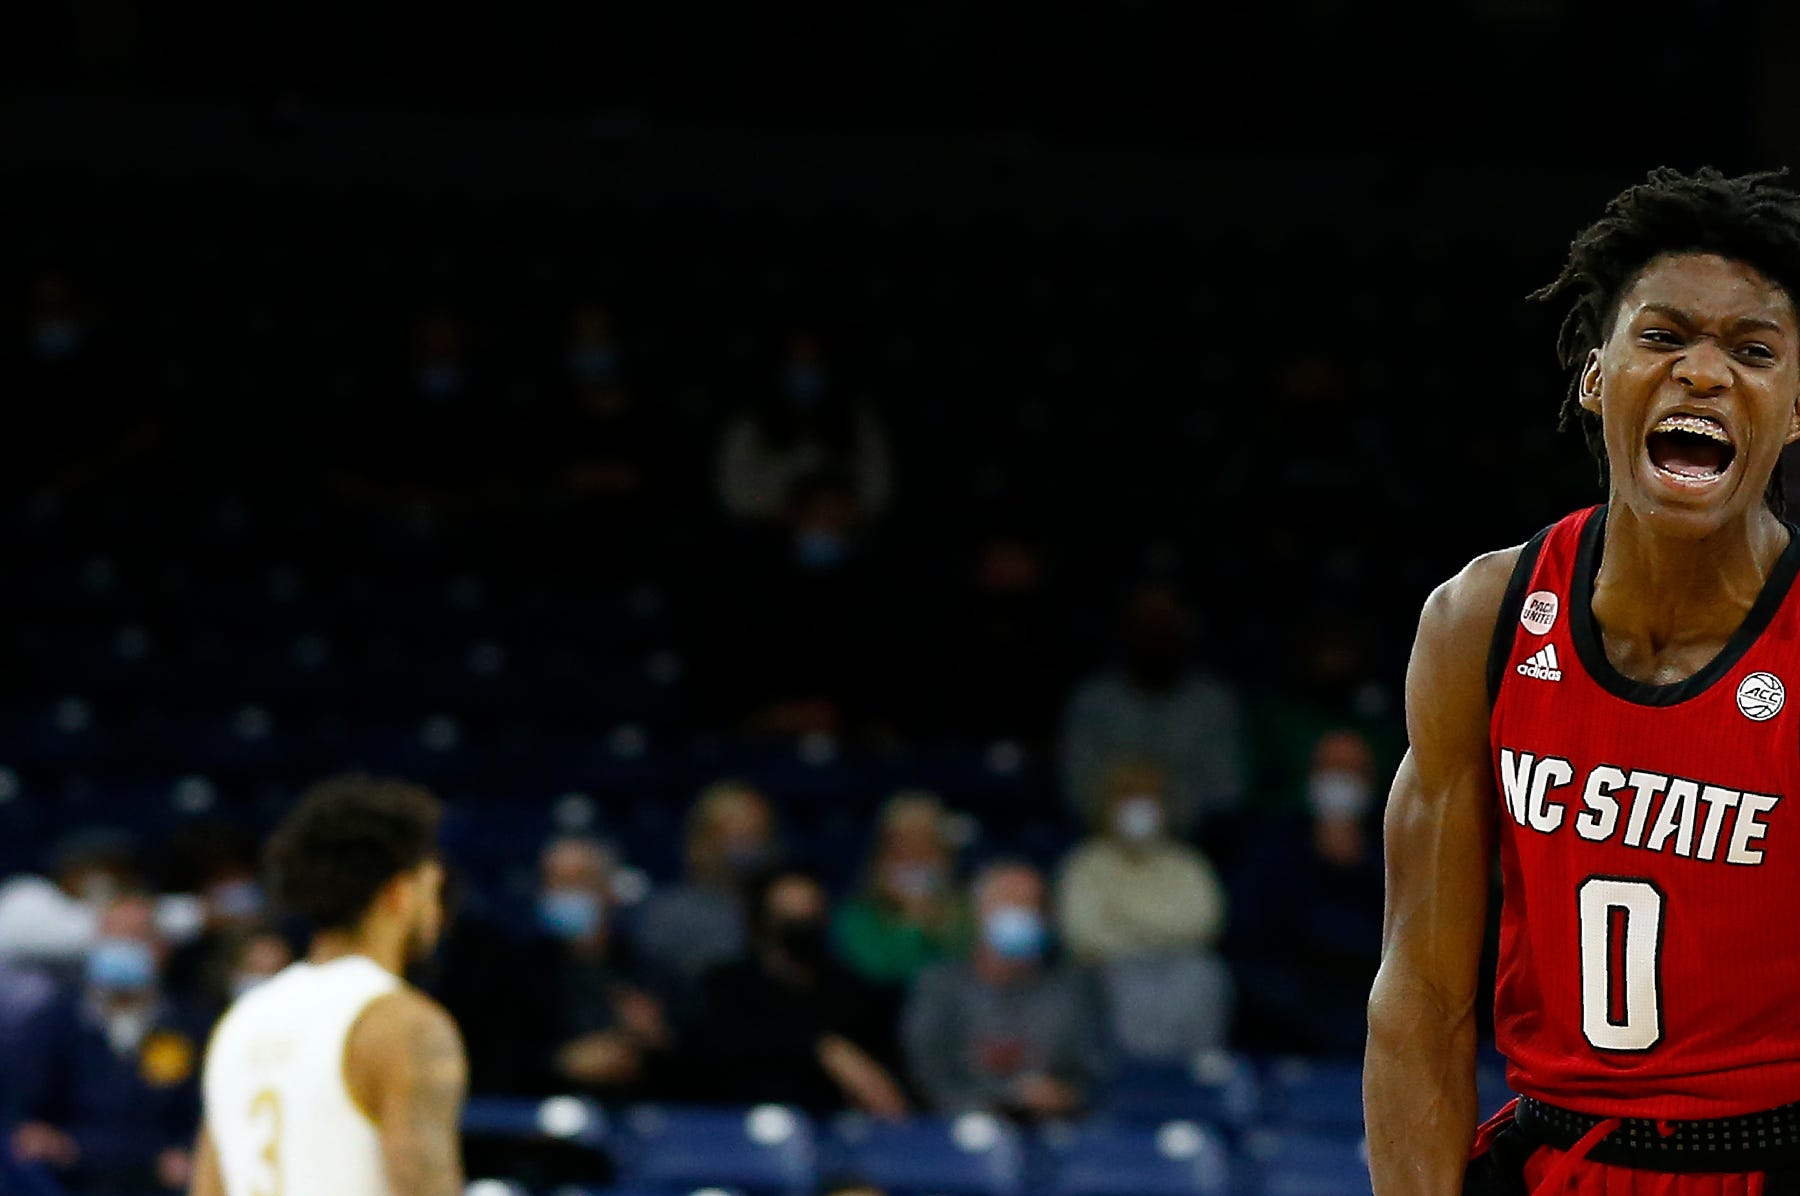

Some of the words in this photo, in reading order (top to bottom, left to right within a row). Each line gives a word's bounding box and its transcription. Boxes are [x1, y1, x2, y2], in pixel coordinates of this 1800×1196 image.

[1516, 663, 1562, 682] adidas
[1744, 687, 1782, 704] ACC
[1500, 747, 1575, 834] NC
[1574, 763, 1782, 866] STATE
[1577, 875, 1663, 1053] 0
